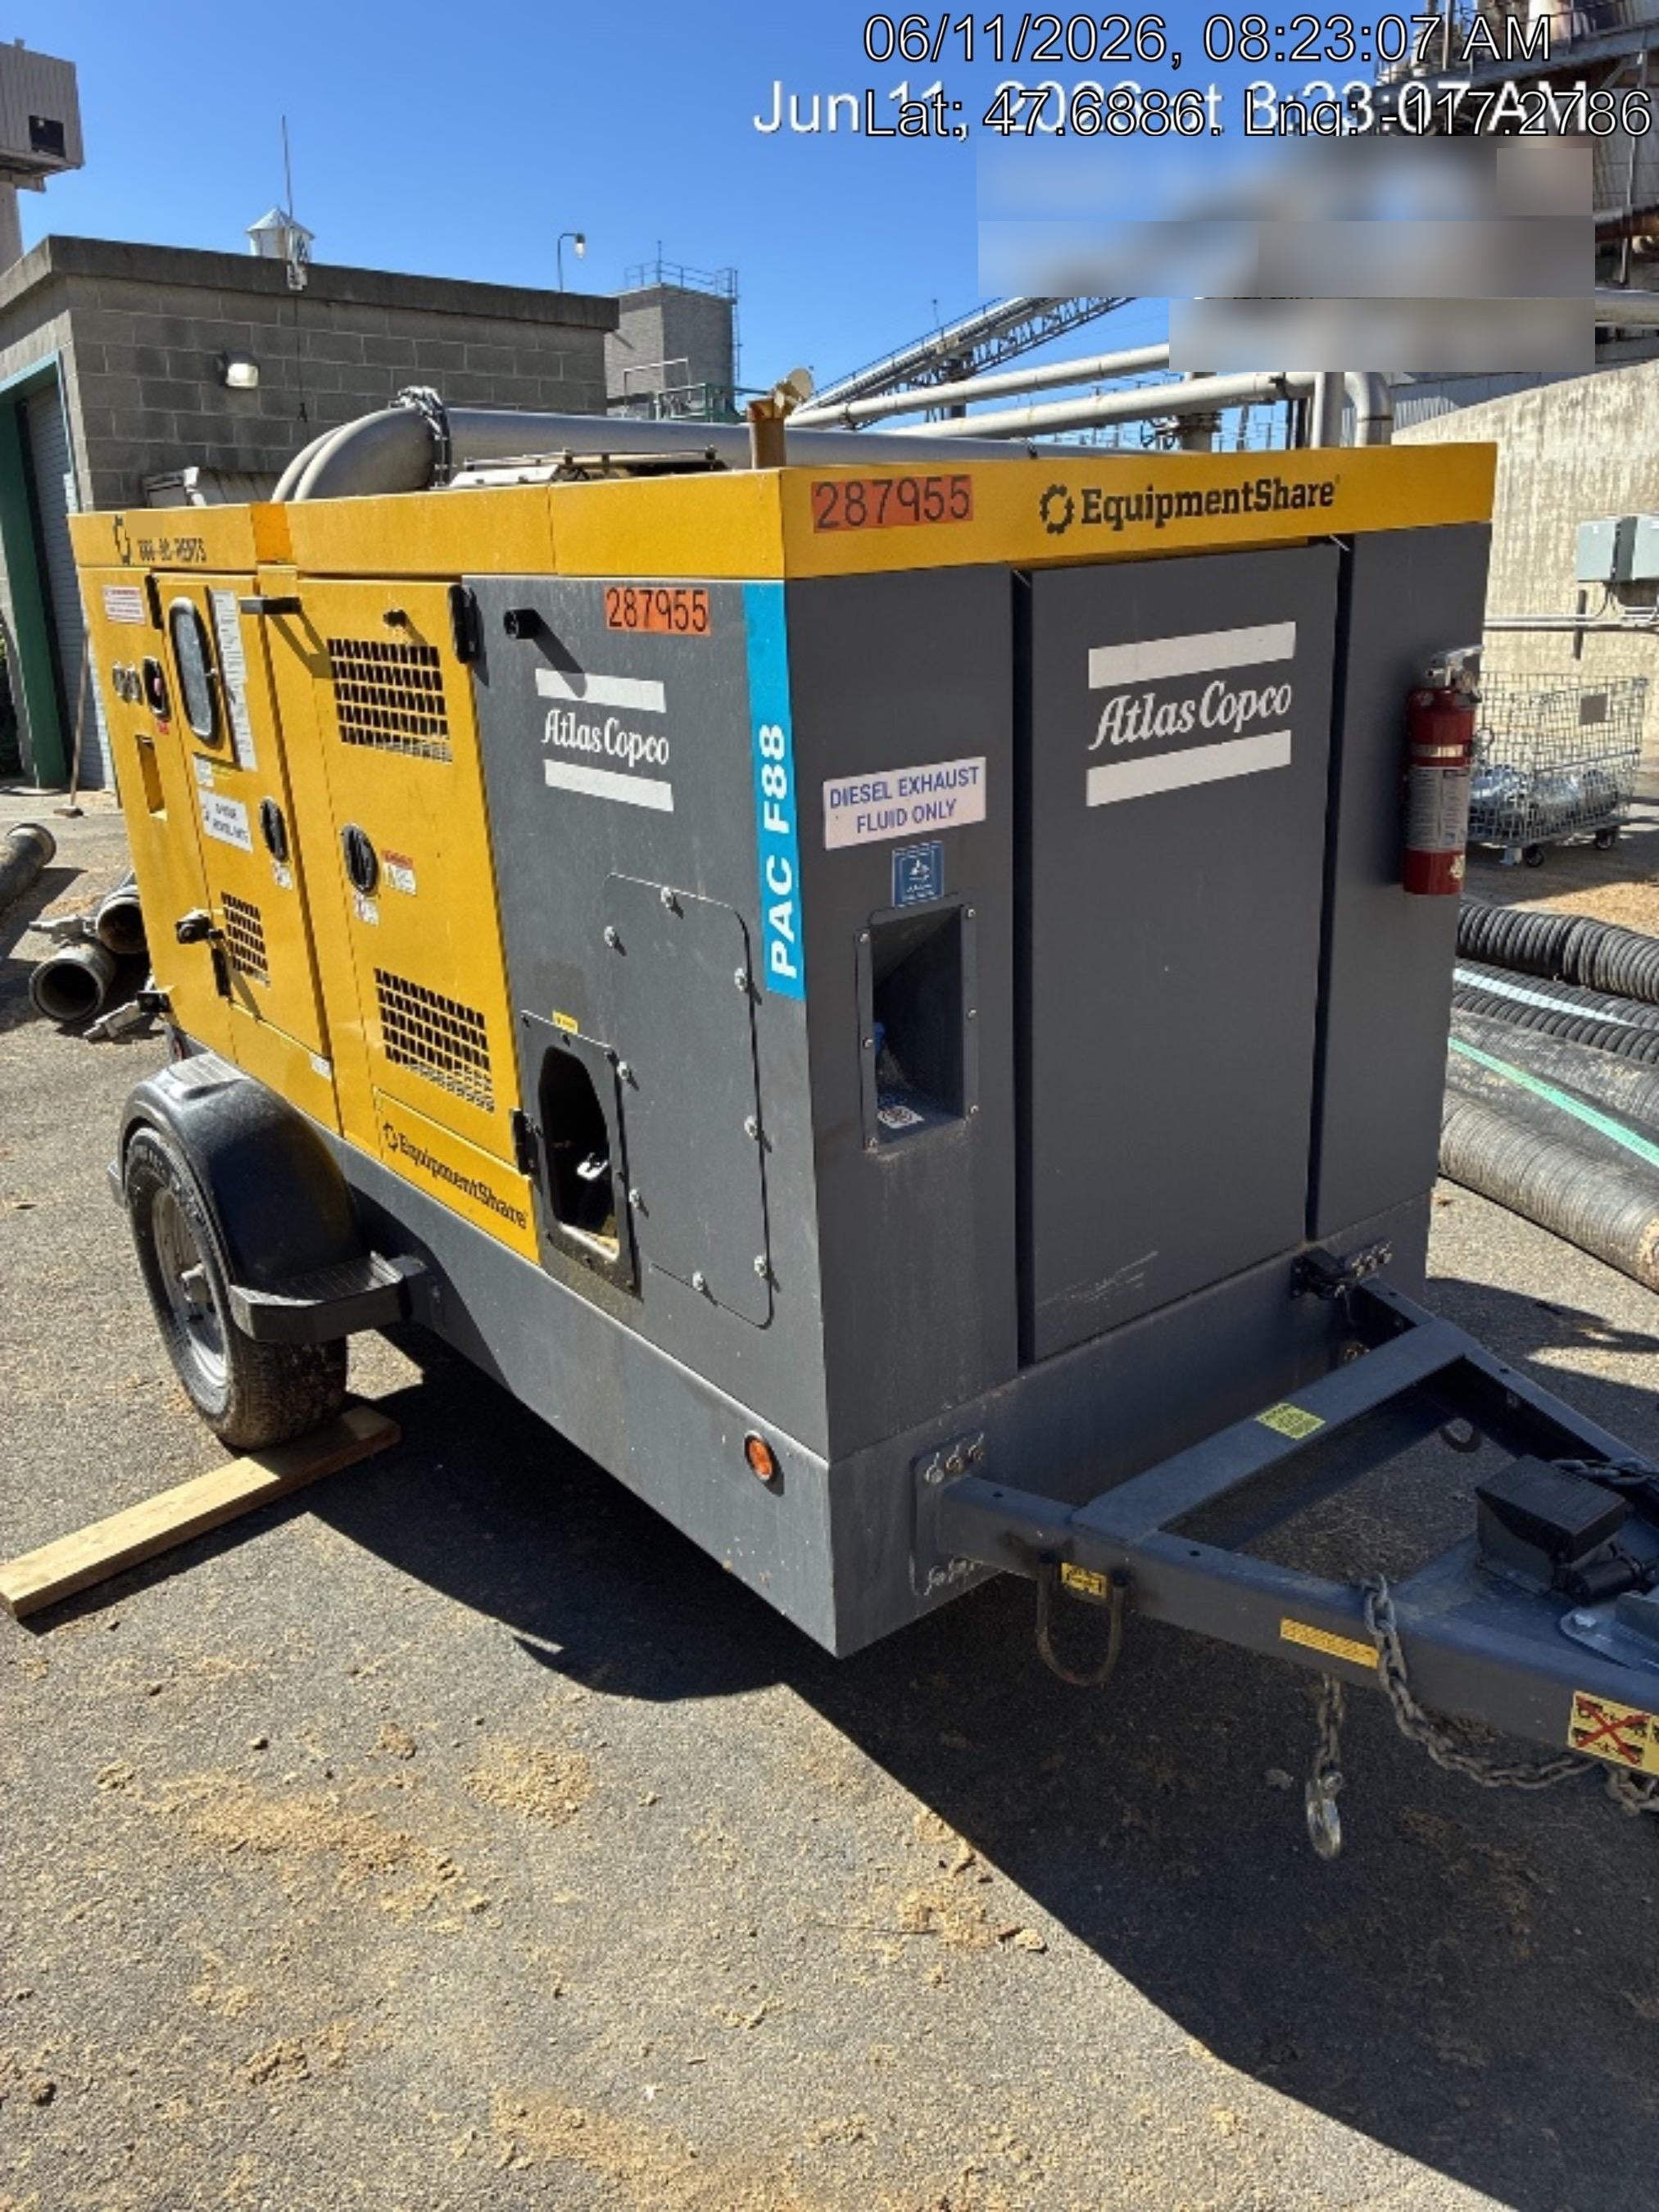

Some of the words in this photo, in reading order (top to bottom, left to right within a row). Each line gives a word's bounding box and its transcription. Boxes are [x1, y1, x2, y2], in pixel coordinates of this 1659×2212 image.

[815, 474, 970, 529] 287955
[1081, 476, 1335, 531] EquipmentShare
[606, 587, 707, 632] 287955
[541, 708, 603, 753] Atlas
[603, 716, 669, 768] Copco
[1088, 691, 1195, 751] Atlas
[1199, 679, 1291, 733] Copco
[759, 724, 790, 834] F88
[830, 781, 892, 809] DIESEL
[898, 766, 980, 797] EXHAUST
[857, 808, 908, 834] FLUID
[912, 798, 957, 824] ONLY
[765, 854, 797, 979] PAC
[397, 1133, 527, 1230] EquipmentShare
